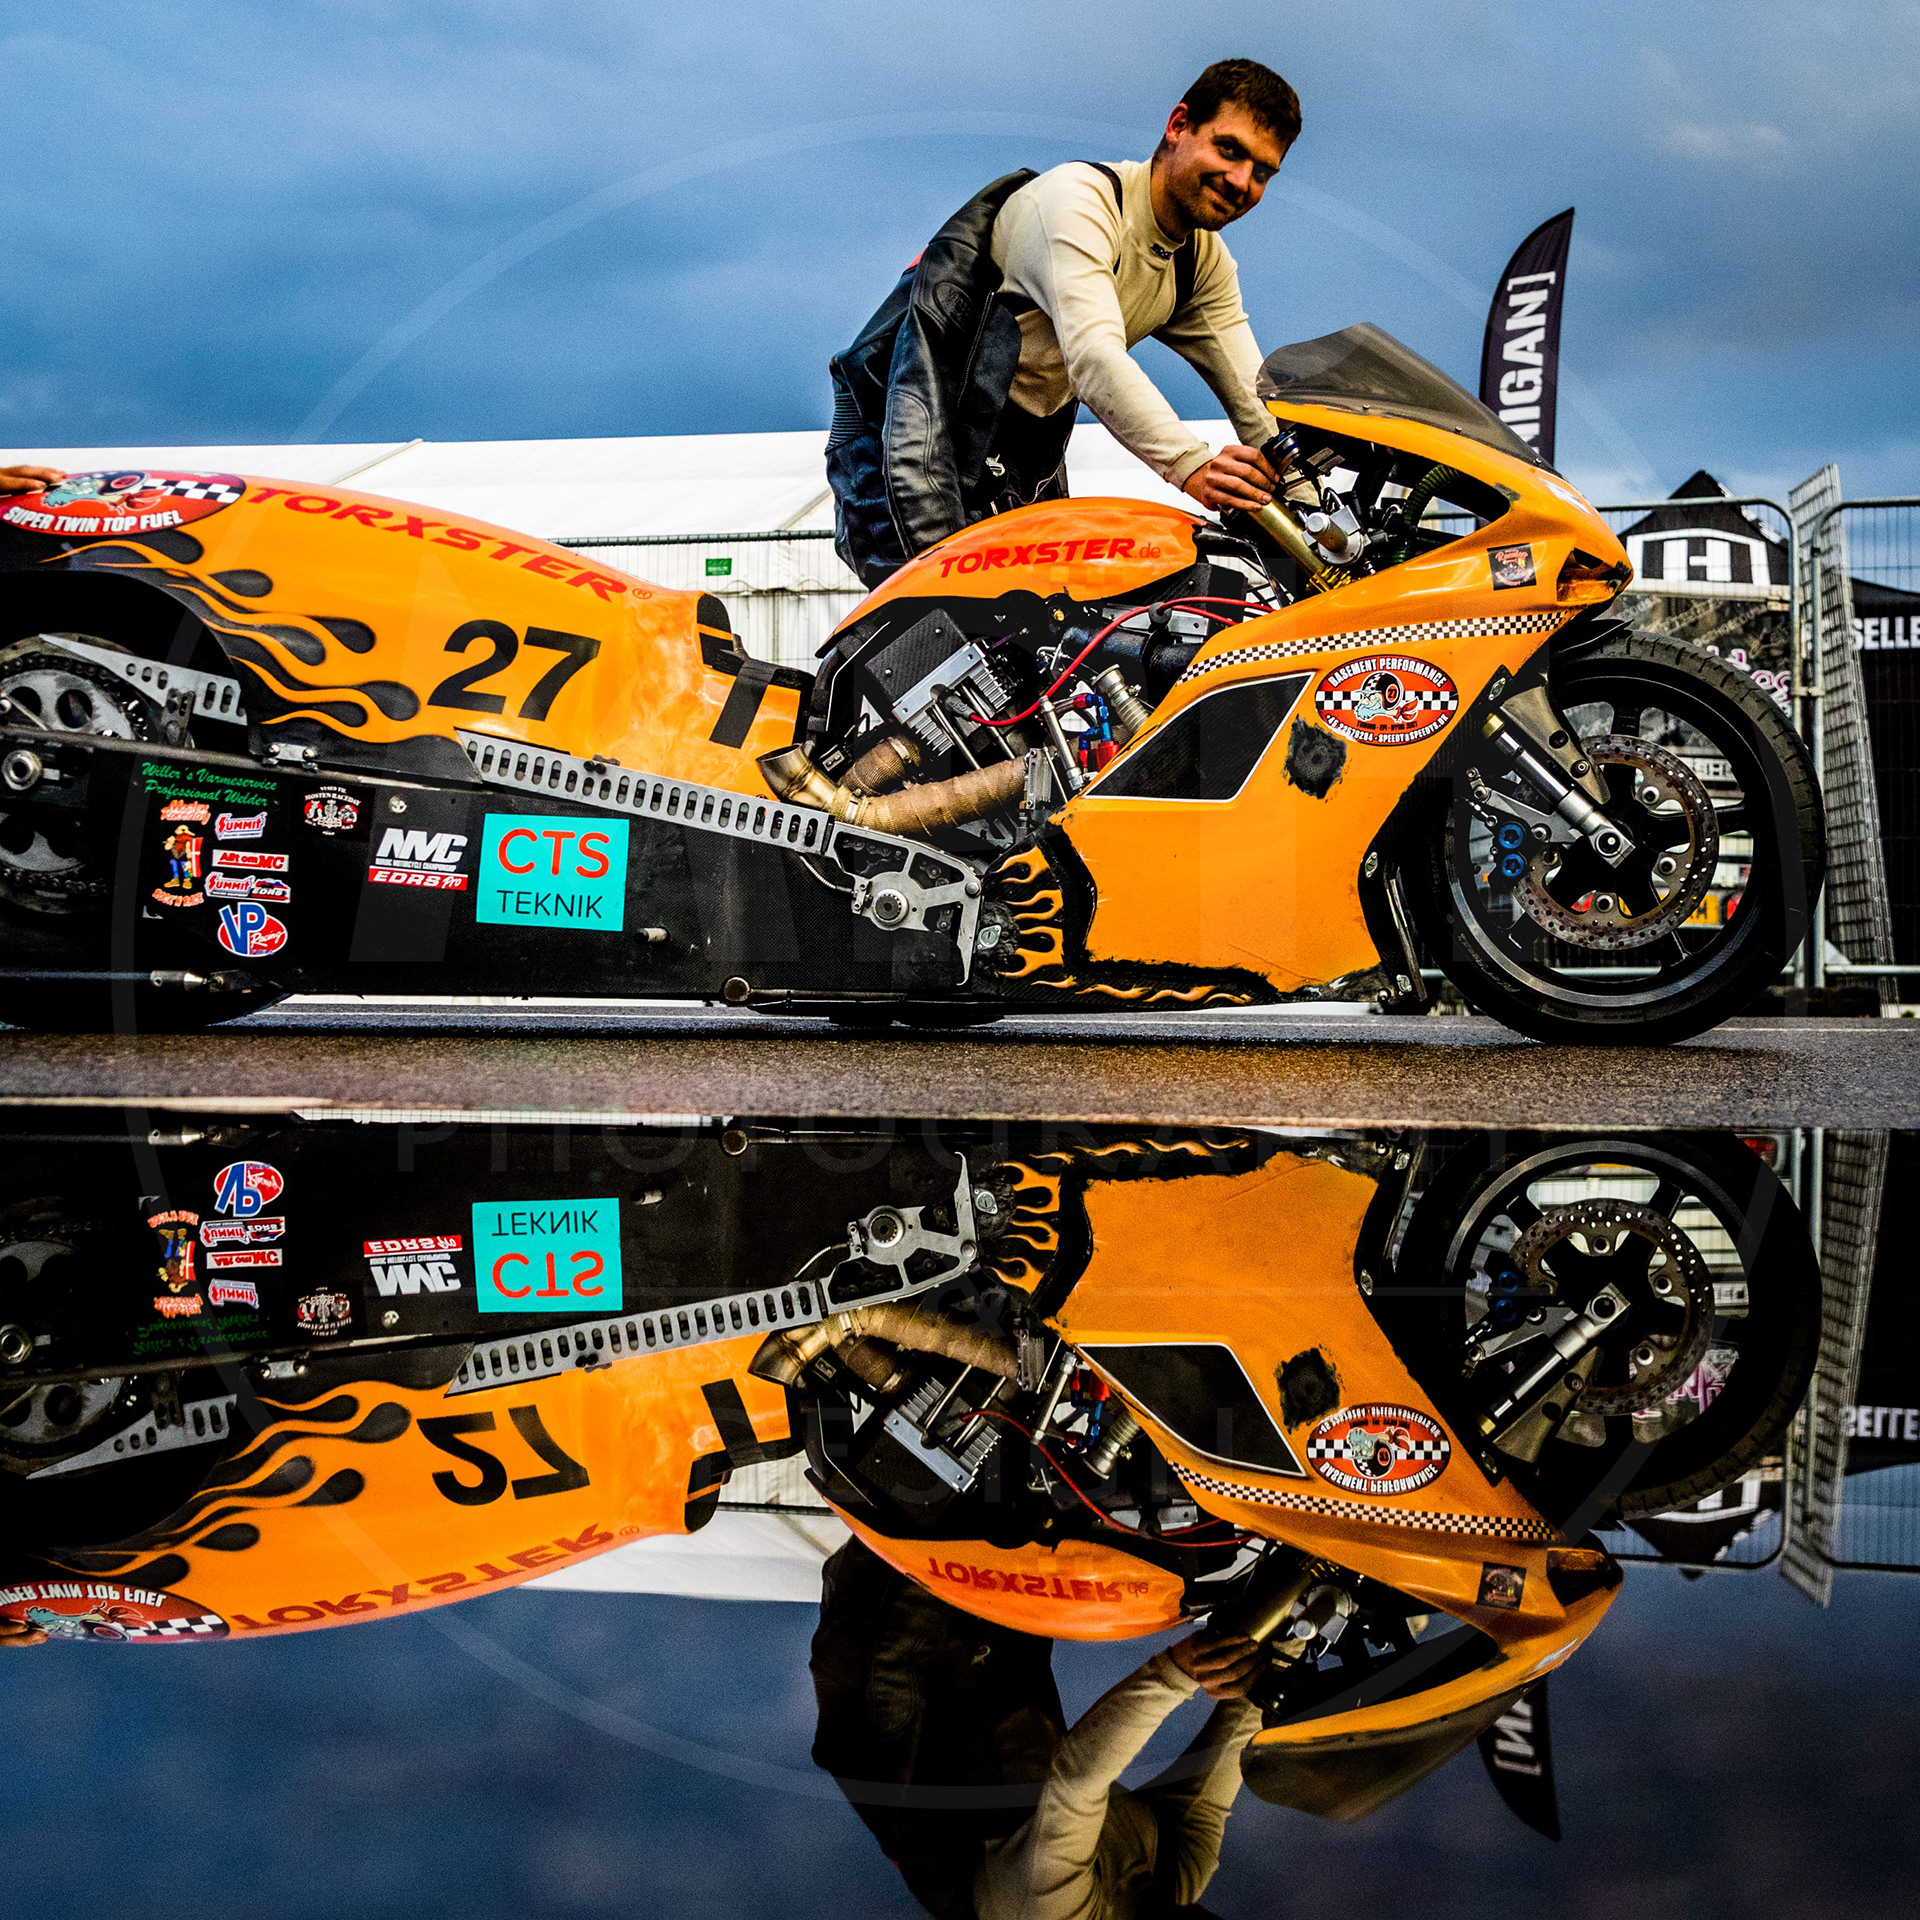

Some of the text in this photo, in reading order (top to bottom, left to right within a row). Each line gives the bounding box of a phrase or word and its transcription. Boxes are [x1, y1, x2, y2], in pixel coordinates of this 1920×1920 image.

[3, 506, 184, 533] SUPER TWIN TOP FUEL
[427, 619, 602, 722] 27
[1327, 657, 1448, 688] BASEMENT PERFORMANCE
[144, 779, 268, 807] Professional Welder
[375, 827, 468, 863] NMC
[497, 828, 610, 879] CTS
[259, 855, 285, 869] MC
[373, 871, 462, 889] EDRS Pro
[496, 890, 603, 919] TEKNIK
[218, 902, 266, 956] VP
[250, 930, 286, 949] Racing
